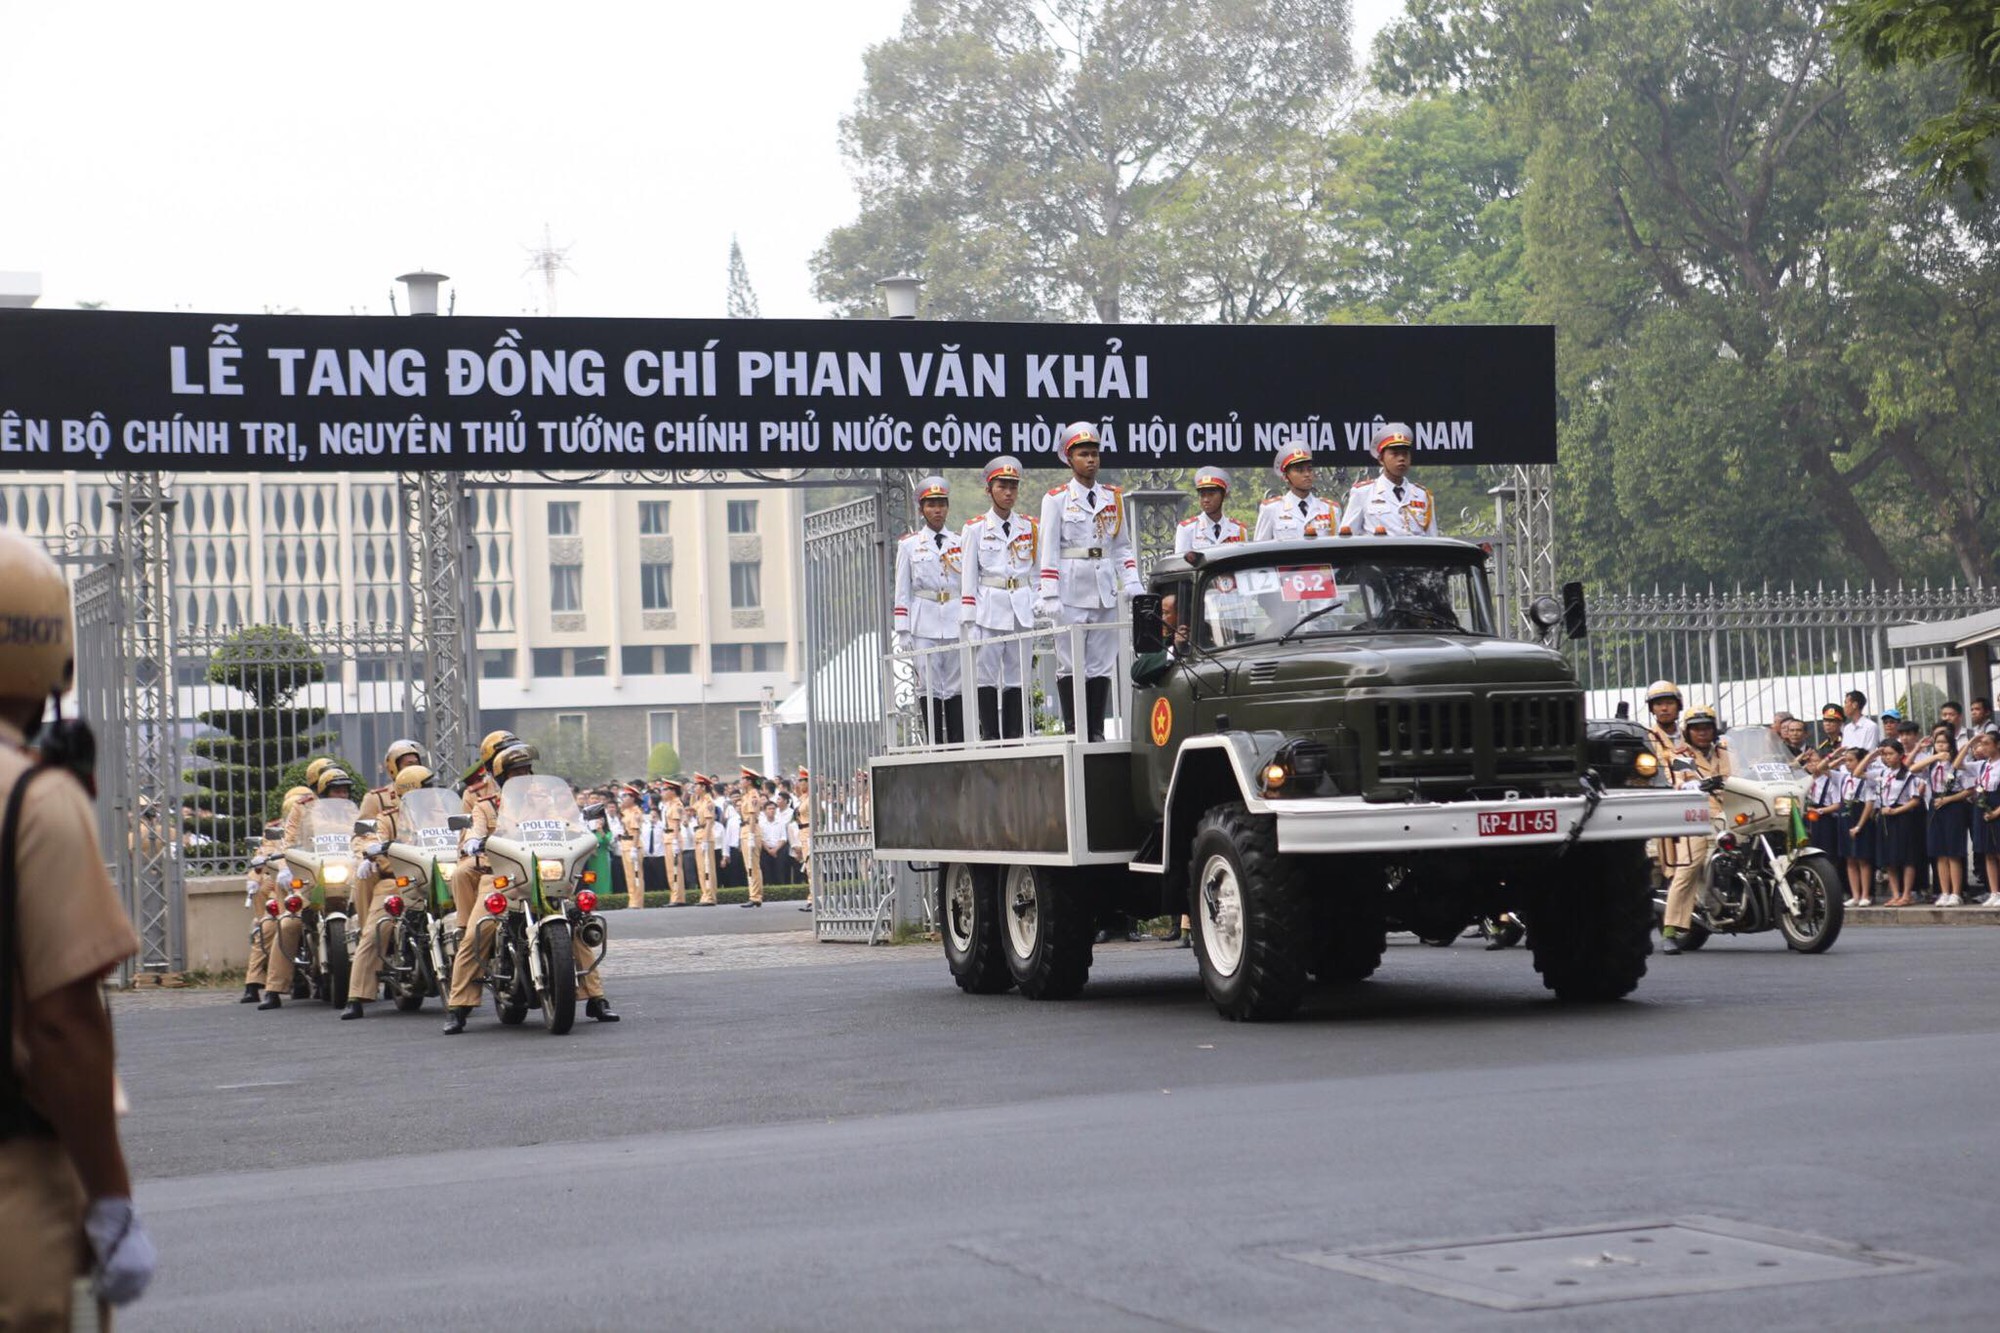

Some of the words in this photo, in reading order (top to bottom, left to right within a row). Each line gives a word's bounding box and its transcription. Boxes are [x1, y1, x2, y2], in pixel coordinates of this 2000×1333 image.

[170, 322, 244, 395] LỄ
[268, 348, 426, 397] TANG
[445, 328, 606, 397] ĐỒNG
[623, 339, 719, 397] CHÍ
[738, 350, 882, 397] PHAN
[900, 343, 1006, 398] VĂN
[1026, 337, 1149, 399] KHẢI
[0, 409, 50, 452] ÊN
[61, 410, 111, 460] BỘ
[123, 412, 229, 455] CHÍNH
[240, 422, 307, 462] TRỊ,
[319, 413, 452, 455] NGUYÊN
[460, 409, 526, 454] THỦ
[537, 413, 645, 454] TƯỚNG
[654, 413, 748, 453] CHÍNH
[760, 410, 820, 453] PHỦ
[832, 413, 913, 453] NƯỚC
[922, 414, 1002, 459] CỘNG
[1128, 415, 1177, 459] HỘI
[1186, 410, 1242, 453] CHỦ
[1254, 414, 1336, 452] NGHĨA
[1415, 421, 1474, 451] NAM
[421, 827, 459, 837] POLICE
[522, 820, 562, 831] POLICE
[1479, 811, 1555, 834] KP-41-65
